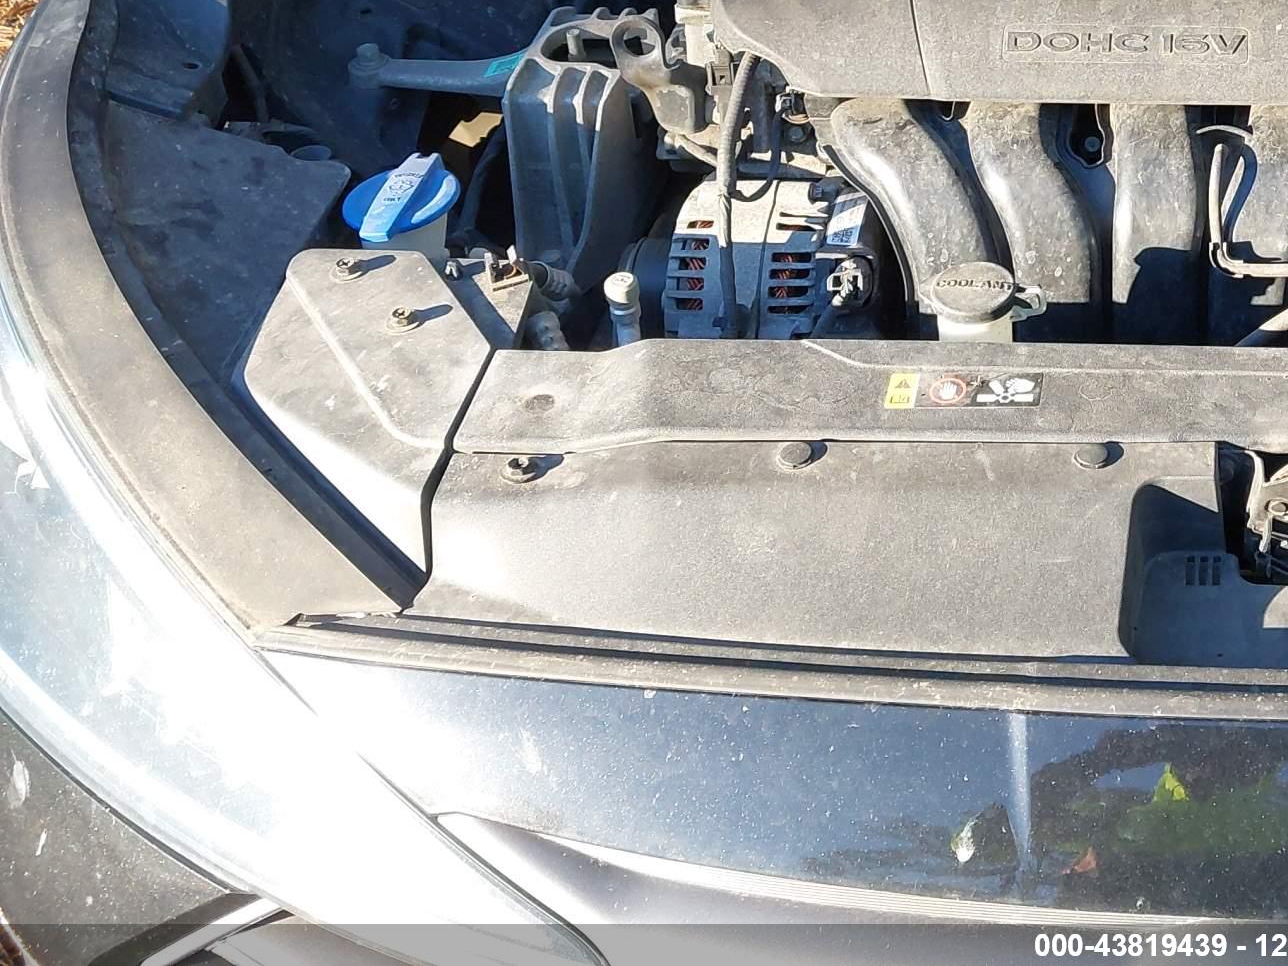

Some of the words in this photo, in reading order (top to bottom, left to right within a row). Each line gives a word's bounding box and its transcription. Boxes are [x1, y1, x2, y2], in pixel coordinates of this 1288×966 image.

[1005, 31, 1149, 53] DOHC
[1161, 33, 1248, 55] 16V
[935, 278, 1014, 291] COOLANT
